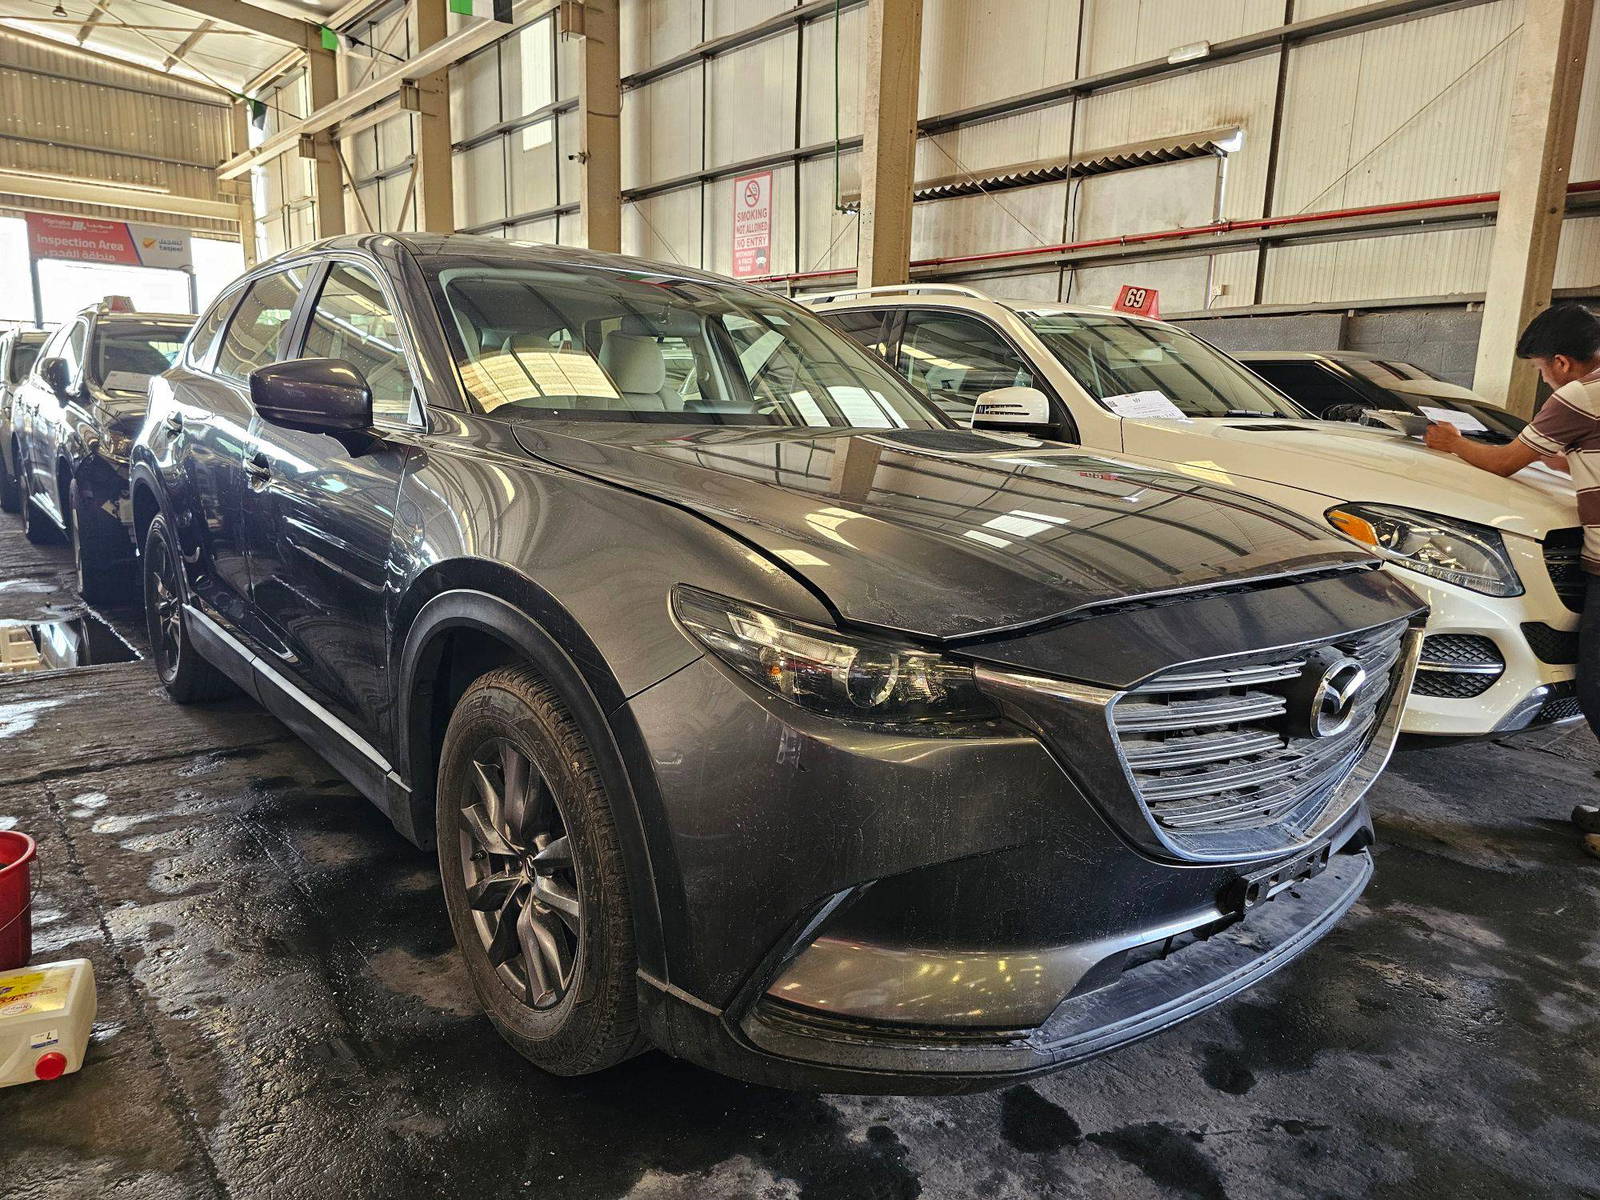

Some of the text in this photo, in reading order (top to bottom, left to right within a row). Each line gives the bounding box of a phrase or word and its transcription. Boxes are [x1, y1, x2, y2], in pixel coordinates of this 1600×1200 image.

[737, 208, 767, 222] SMOKING
[737, 222, 767, 234] NOT ALLOWED
[37, 234, 124, 251] Inspection Area
[737, 236, 766, 249] NO ENTRY
[82, 249, 116, 261] منطقة
[1124, 288, 1146, 308] 69
